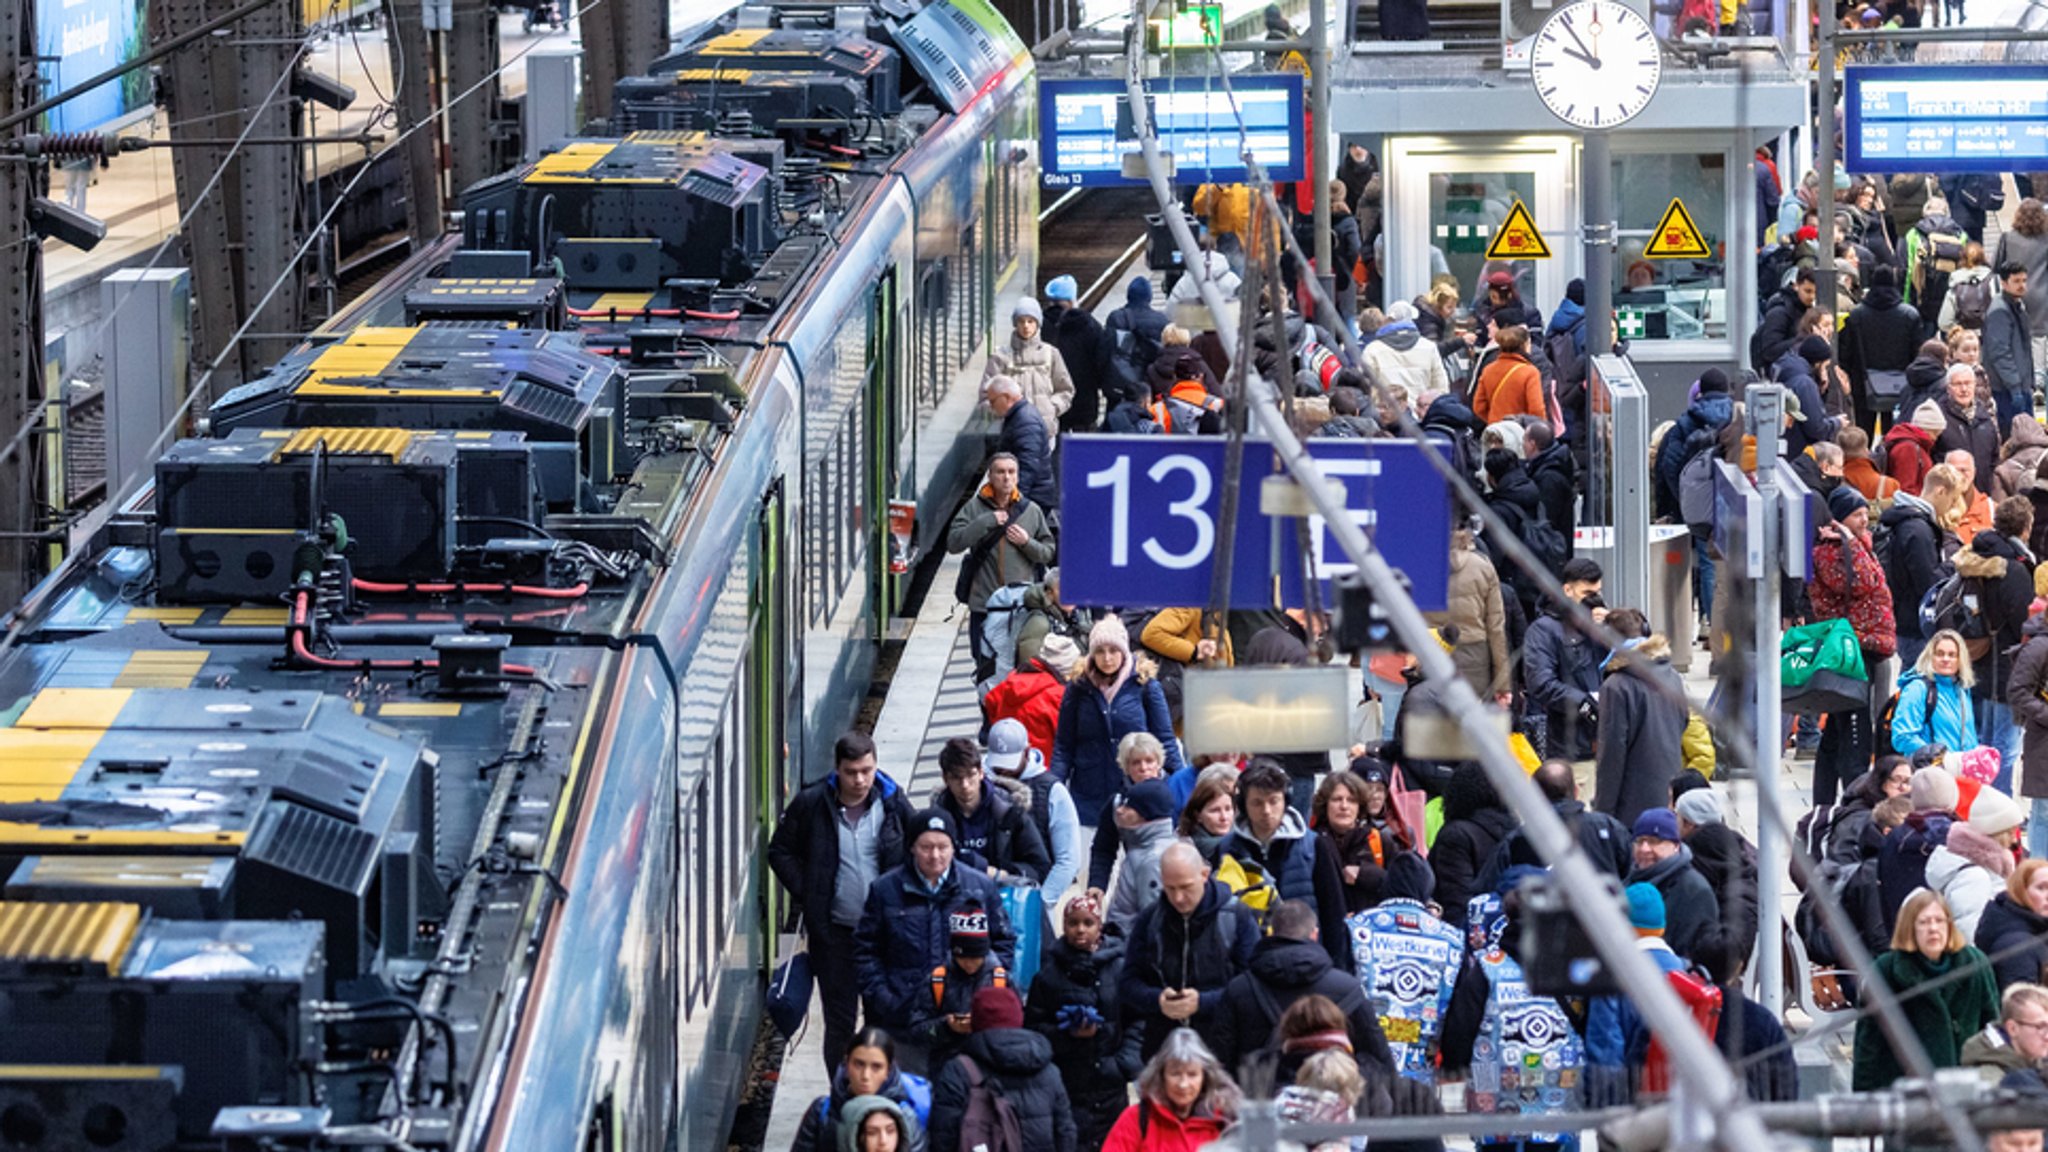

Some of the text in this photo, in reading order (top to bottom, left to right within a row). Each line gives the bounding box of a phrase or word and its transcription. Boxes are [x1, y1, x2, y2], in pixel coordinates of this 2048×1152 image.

[1044, 173, 1083, 185] Gleis 13
[1086, 454, 1382, 580] 13 E
[1374, 936, 1448, 958] Westkurve
